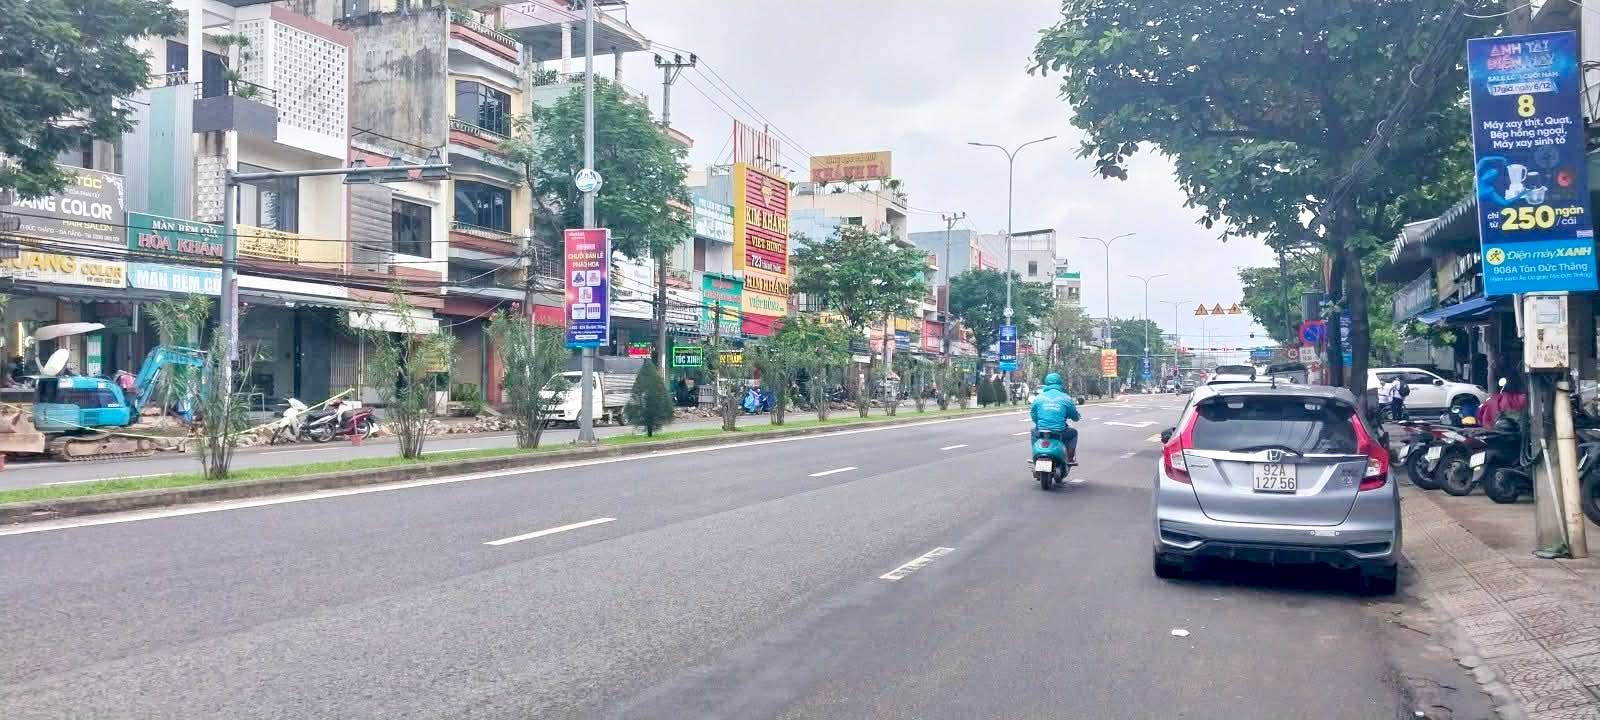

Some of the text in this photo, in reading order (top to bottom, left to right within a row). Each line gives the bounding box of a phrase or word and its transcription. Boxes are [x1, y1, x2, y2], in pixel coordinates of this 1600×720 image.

[1534, 82, 1551, 91] 6/12
[1518, 95, 1536, 117] 8
[1483, 117, 1572, 130] Máy xay thịt, Quạt,
[1490, 125, 1567, 140] Bếp hồng ngoại,
[1493, 134, 1566, 149] Máy xay sinh tố
[61, 197, 113, 220] COLOR
[746, 206, 761, 227] KIM
[762, 210, 787, 236] KHÁNH
[1501, 205, 1555, 230] 250
[1555, 205, 1584, 217] ngàn
[83, 221, 113, 231] SALON
[152, 219, 175, 231] MÀN
[138, 230, 171, 250] HÒA
[1506, 250, 1532, 260] Điện
[81, 262, 121, 278] COLOR
[1494, 262, 1588, 274] 908A Tôn Đức Thắng
[1263, 464, 1285, 476] 92A
[1255, 477, 1295, 489] 127.56
